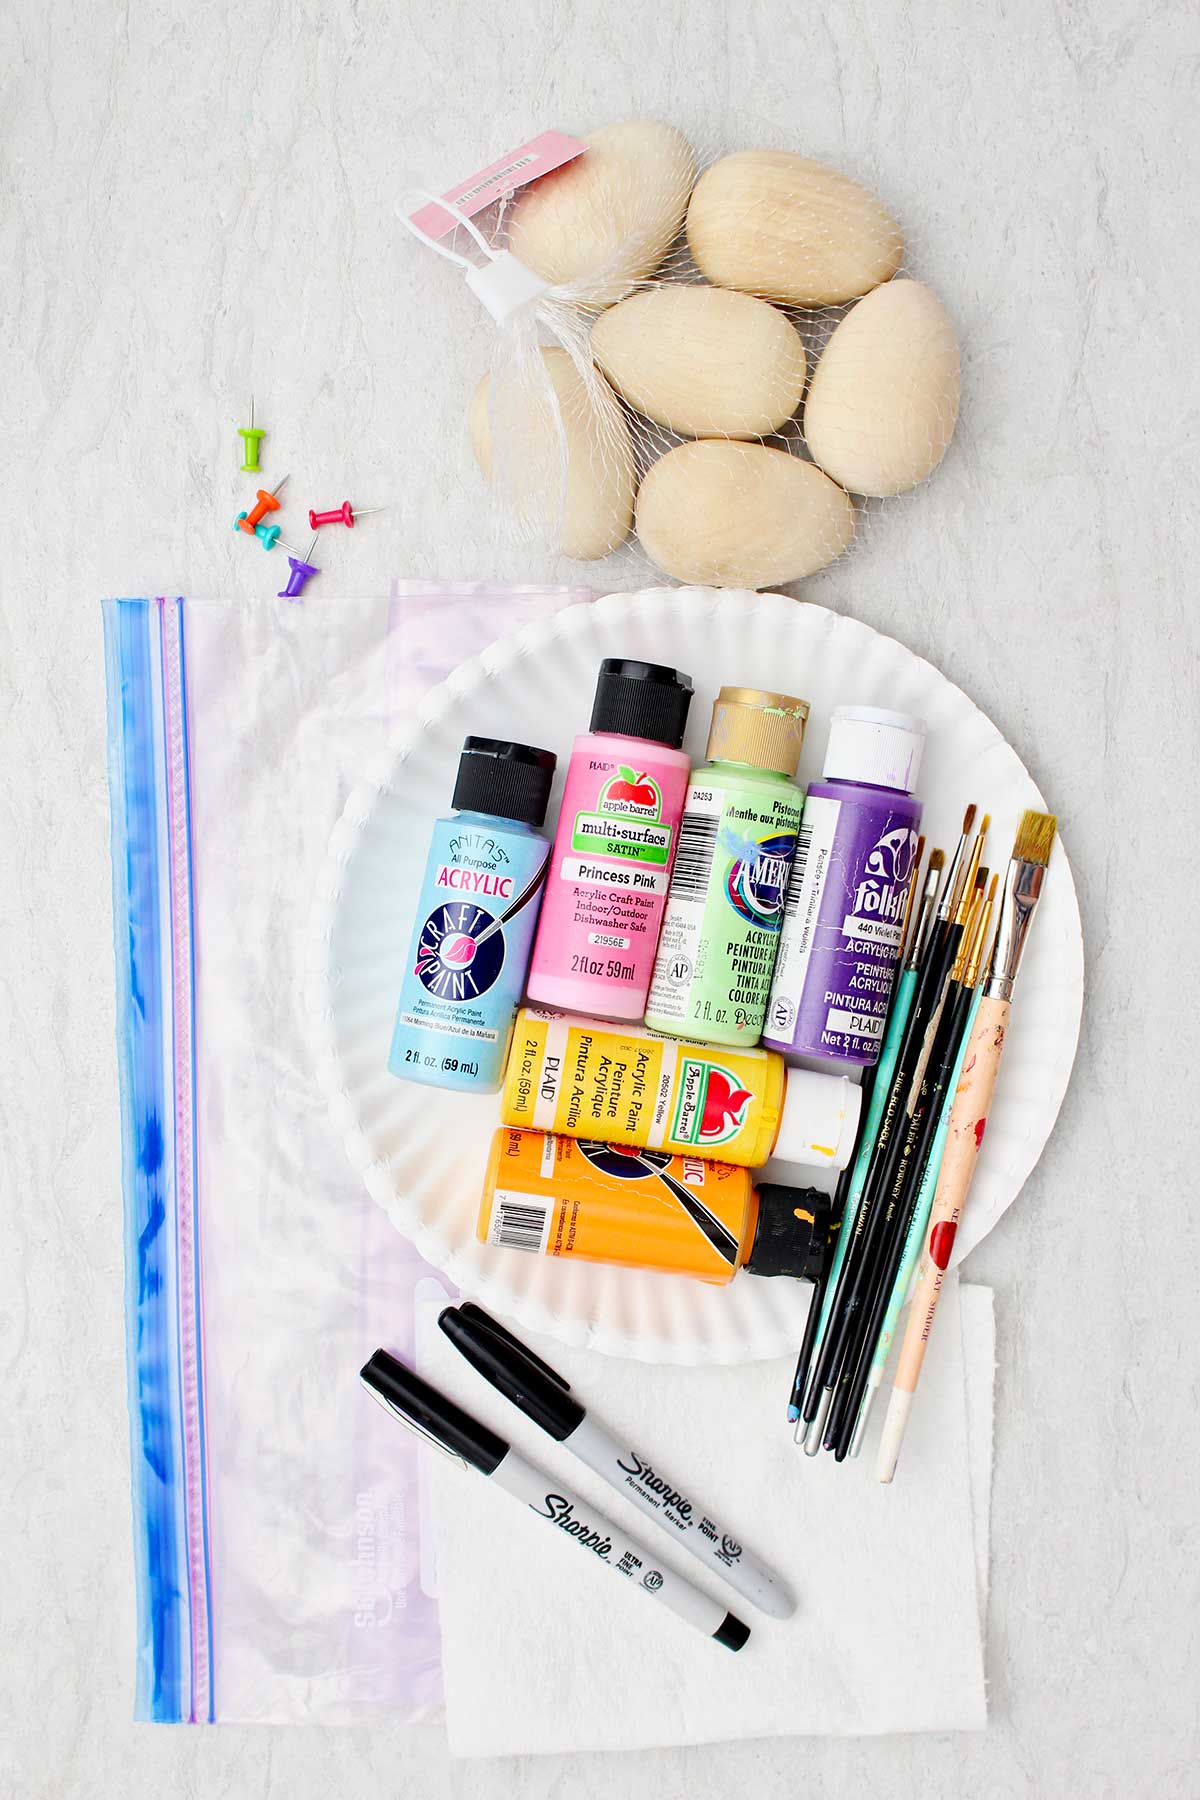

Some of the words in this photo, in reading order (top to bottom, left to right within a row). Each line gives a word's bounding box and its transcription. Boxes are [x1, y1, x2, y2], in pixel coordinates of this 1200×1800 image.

[692, 791, 713, 801] DA253
[603, 801, 628, 812] apple
[629, 804, 656, 816] barrel
[726, 806, 757, 822] Menthe
[760, 813, 774, 825] aux
[449, 835, 507, 862] ANITA'S
[607, 843, 640, 856] SATIN
[451, 854, 462, 864] All
[463, 856, 497, 871] Purpose
[438, 867, 512, 898] ACRYLIC
[578, 865, 630, 884] Princess
[633, 874, 656, 889] Pink
[573, 888, 607, 900] Acrylic
[608, 893, 633, 905] Craft
[635, 897, 655, 908] Paint
[576, 900, 648, 920] Indoor/Outdoor
[421, 905, 484, 950] CRAFT
[574, 913, 628, 930] Dishwasher
[630, 922, 647, 933] Safe
[858, 922, 874, 934] 440
[594, 935, 625, 948] 21956E
[726, 942, 768, 961] PEINTURE
[571, 955, 579, 972] 2
[580, 956, 588, 973] fl
[589, 962, 604, 976] oz
[670, 962, 689, 978] AP
[731, 958, 766, 976] PINTURA
[421, 961, 480, 999] PAINT
[736, 974, 759, 990] TINTA
[728, 988, 761, 1006] COLORE
[823, 991, 871, 1012] PINTURA
[451, 1014, 486, 1026] Permanente
[467, 1008, 482, 1017] Paint
[694, 1000, 702, 1019] 2
[716, 1009, 728, 1023] oz.
[775, 1002, 788, 1026] AP
[849, 1016, 882, 1034] PLAID
[526, 1040, 538, 1048] 2
[821, 1031, 841, 1046] Net
[843, 1035, 850, 1048] 2
[852, 1037, 860, 1049] fl.
[405, 1050, 413, 1062] 2
[424, 1056, 437, 1068] oz.
[441, 1058, 458, 1072] (59
[460, 1062, 479, 1077] mL)
[575, 1035, 593, 1082] Pintura
[540, 1056, 560, 1101] PLAID
[632, 1052, 650, 1097] Acrylic
[687, 1066, 701, 1101] Apple
[591, 1055, 613, 1118] Acrylique
[607, 1062, 626, 1118] Peinture
[659, 1074, 671, 1098] 20502
[625, 1101, 642, 1132] Paint
[655, 1100, 666, 1124] Yellow
[679, 1102, 696, 1134] Barrel
[892, 1158, 908, 1199] ROWNEY
[855, 1200, 871, 1235] TAIWAN
[921, 1301, 936, 1341] SHADER
[617, 1452, 693, 1521] Sharpie
[625, 1476, 661, 1509] Permanent
[664, 1509, 687, 1531] Marker
[528, 1493, 612, 1560] Sharpie
[698, 1523, 719, 1543] POINT
[615, 1563, 634, 1577] POINT
[619, 1558, 634, 1570] FINE
[624, 1551, 643, 1568] ULTRA
